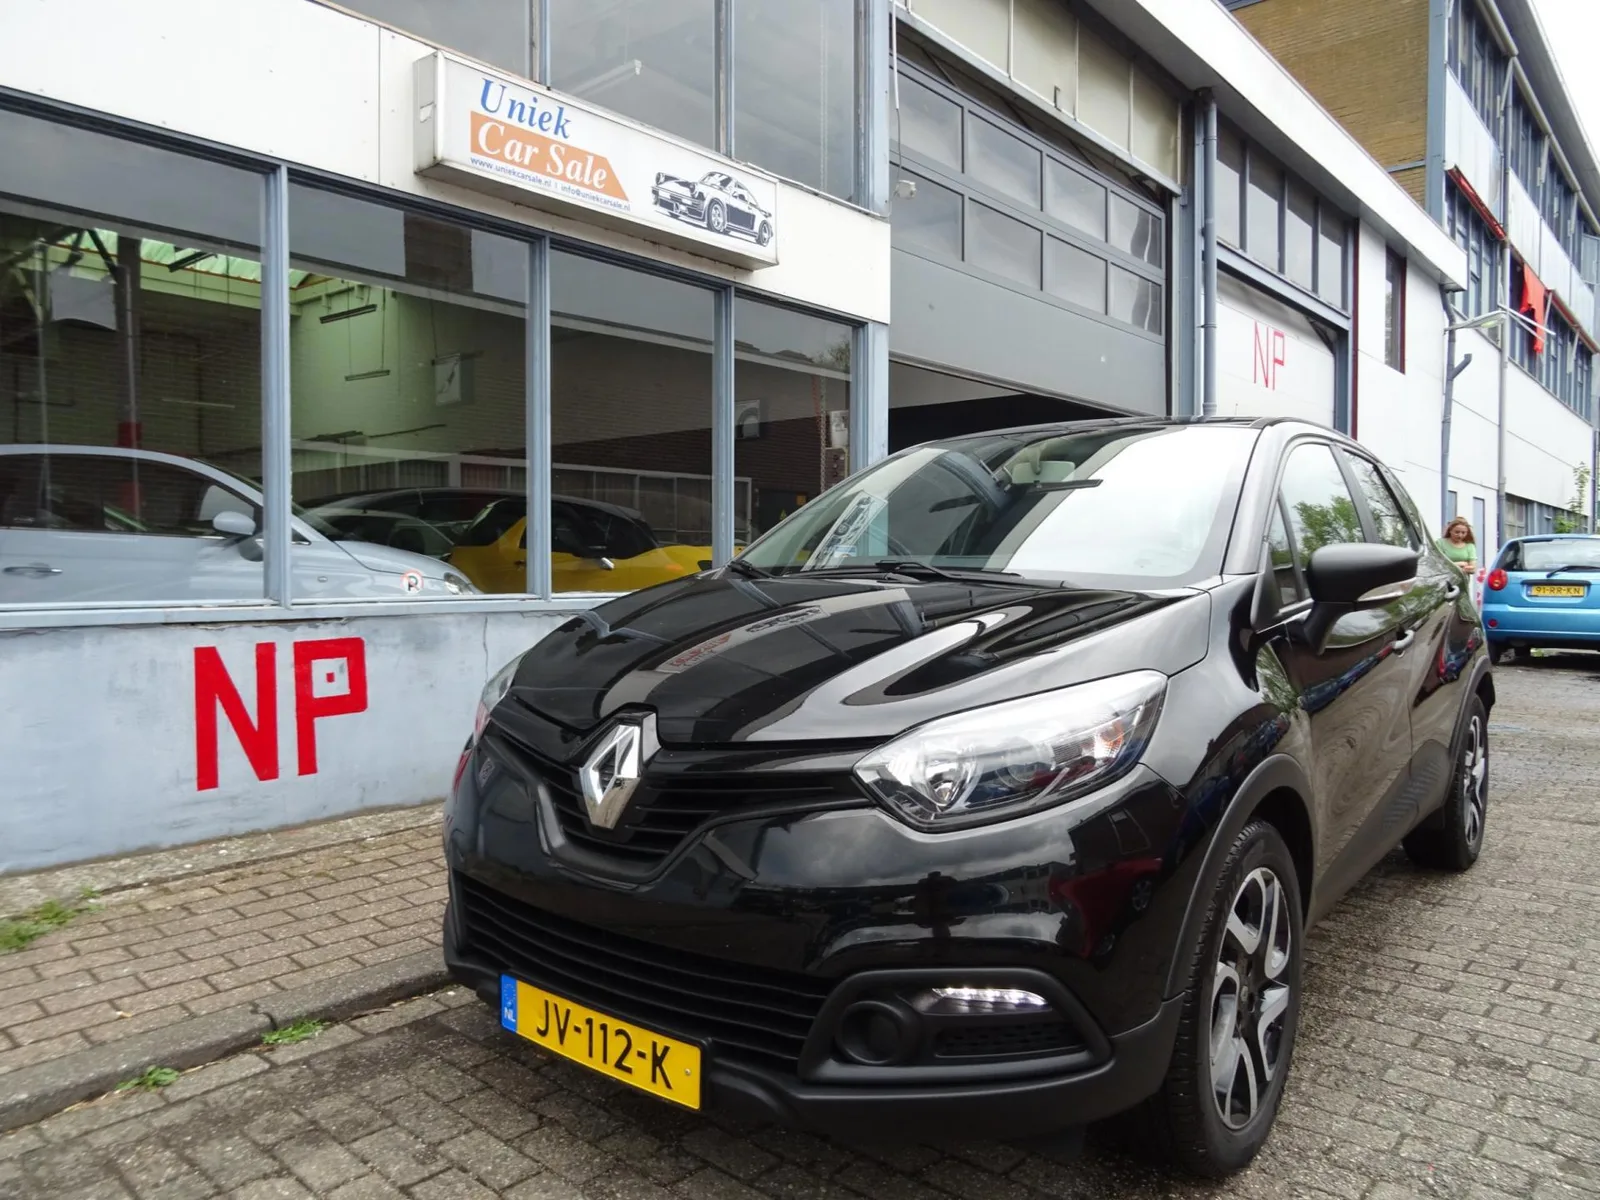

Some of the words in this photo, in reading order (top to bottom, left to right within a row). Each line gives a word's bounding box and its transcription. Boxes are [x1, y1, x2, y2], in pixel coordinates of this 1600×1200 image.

[481, 78, 572, 139] Uniek
[470, 157, 551, 187] www.uniekcarsale.nl
[561, 185, 631, 211] info@uniekcarsale.nl
[478, 121, 539, 166] Car
[546, 143, 607, 189] Sale
[1253, 321, 1285, 391] NP
[1535, 586, 1580, 594] 91-RR-KN
[194, 637, 368, 791] NP
[504, 1008, 516, 1022] NL
[536, 999, 673, 1090] JV-112-K
